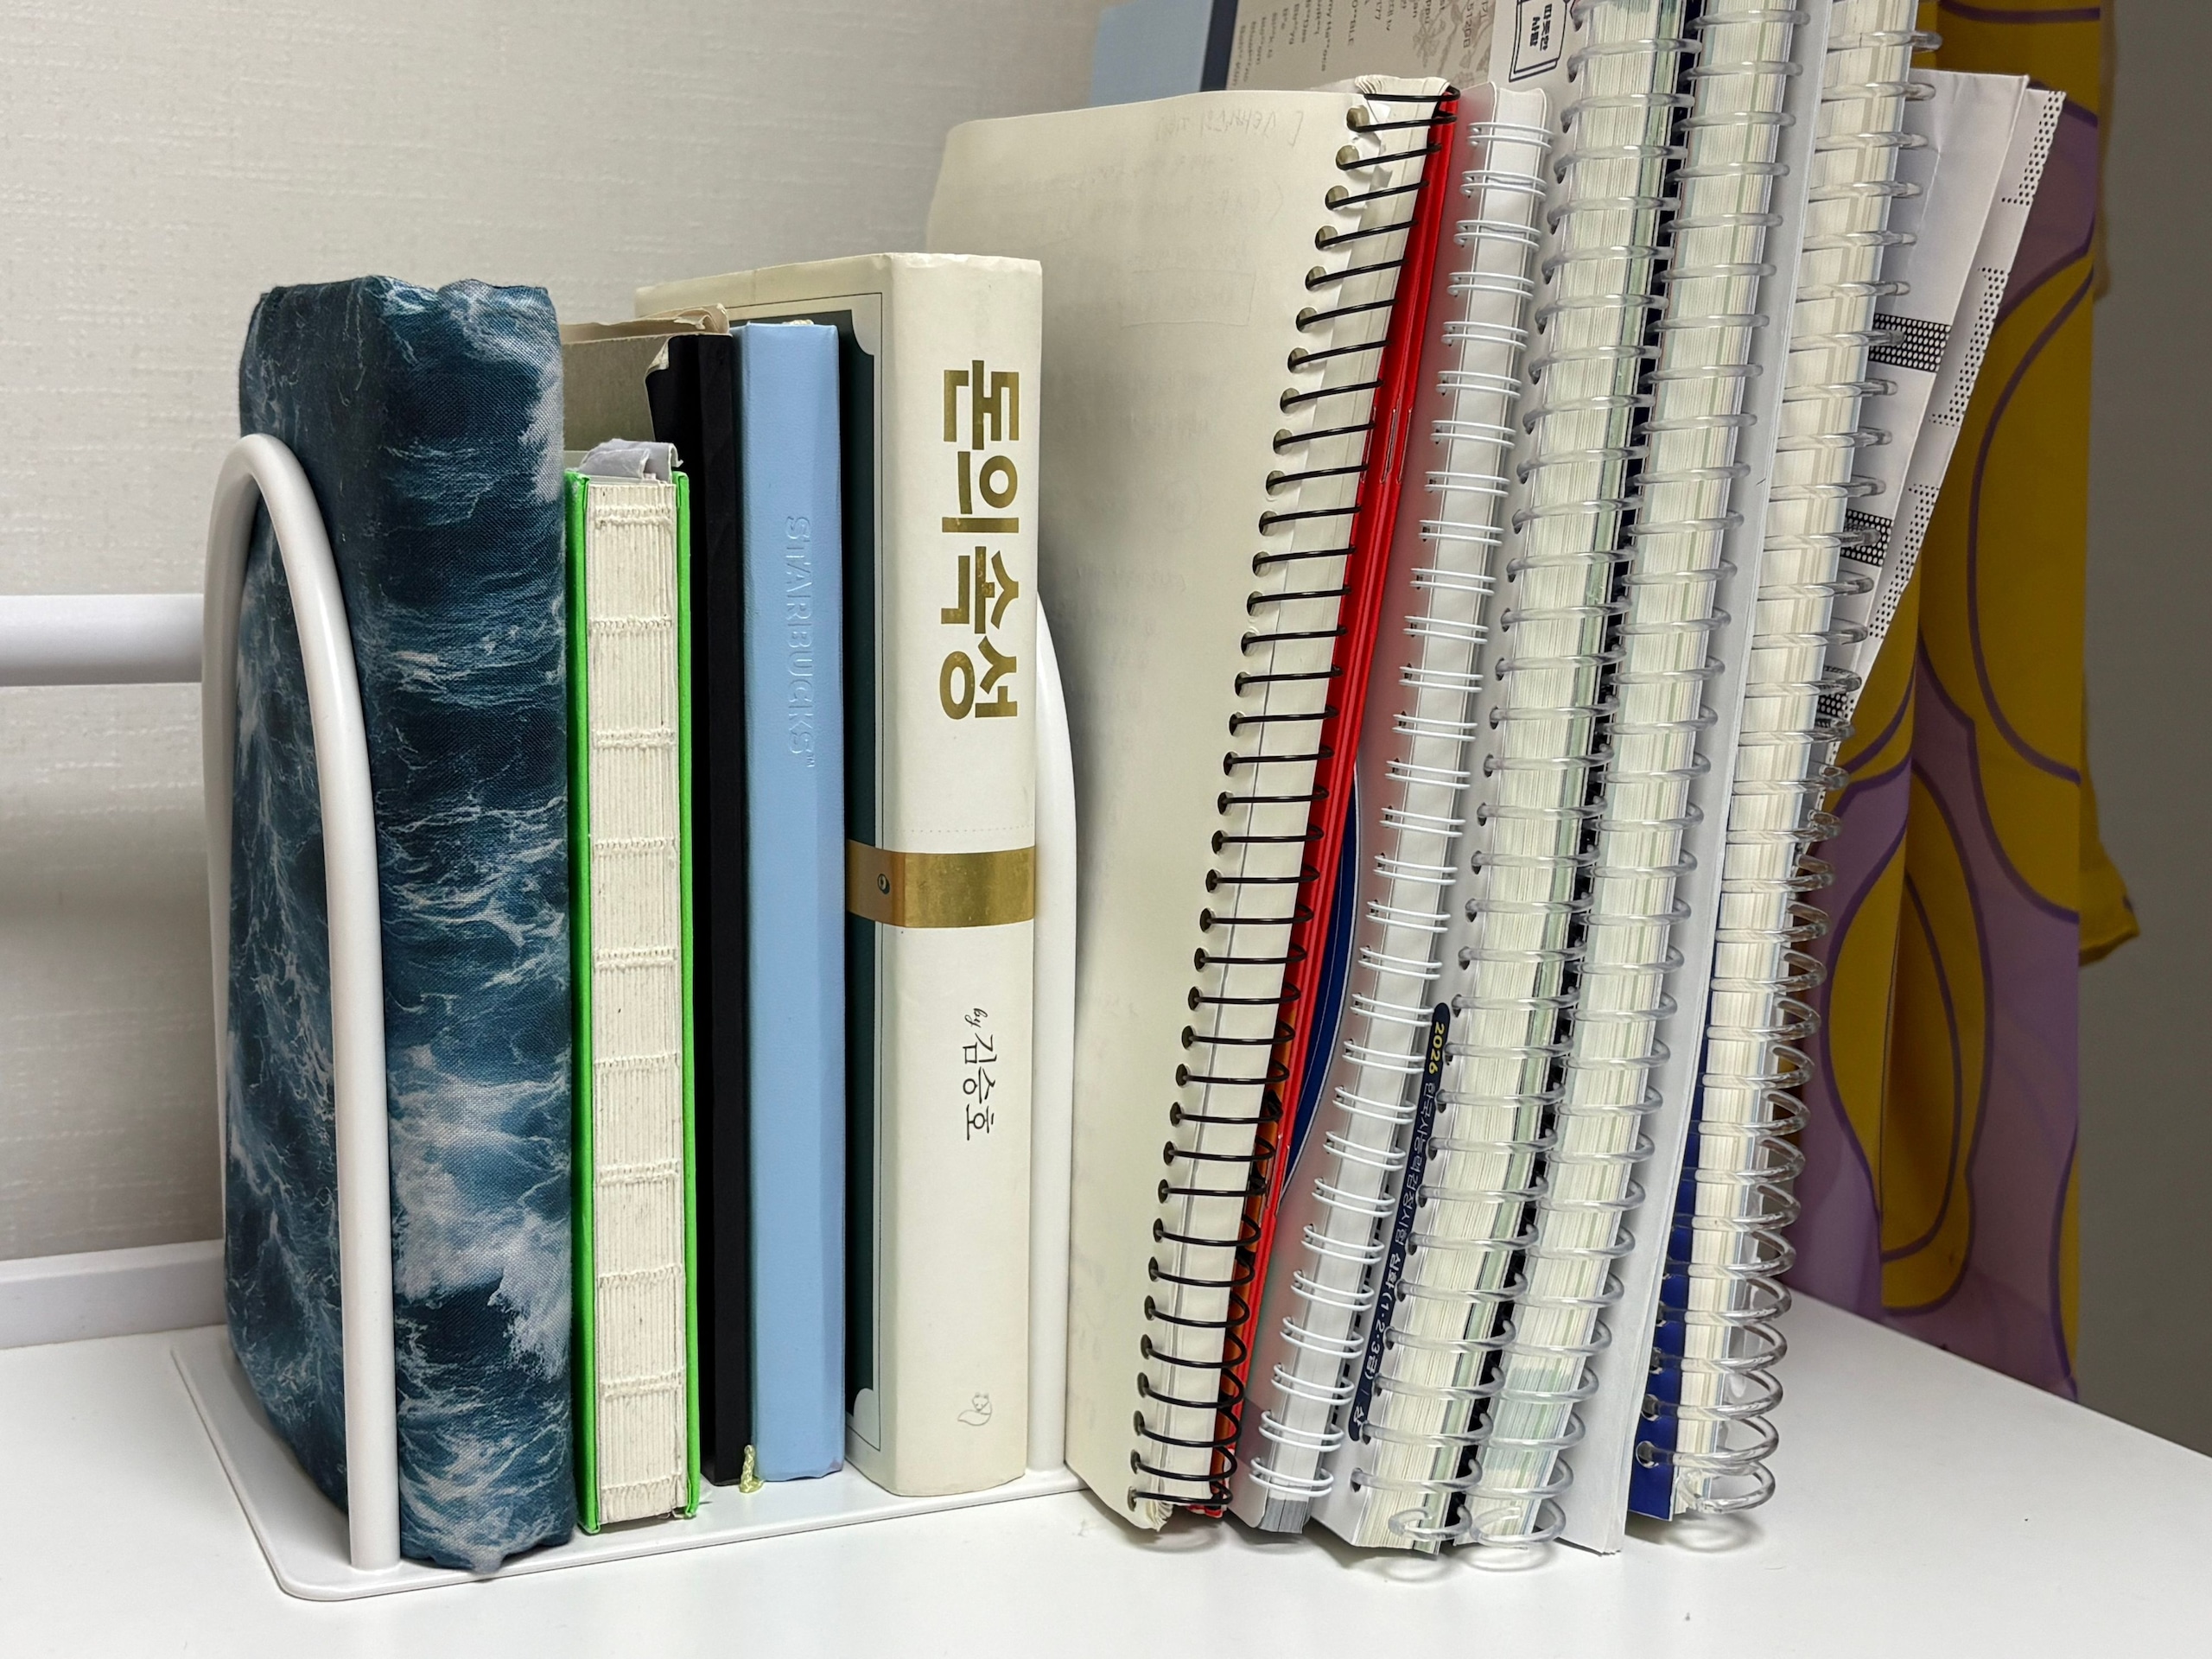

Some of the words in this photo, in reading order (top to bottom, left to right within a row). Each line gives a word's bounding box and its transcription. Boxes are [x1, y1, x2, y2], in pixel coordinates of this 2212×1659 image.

[942, 359, 1019, 533] 돈의
[940, 546, 1019, 720] 속성
[964, 1007, 988, 1028] by
[1428, 1021, 1445, 1074] 2026
[963, 1033, 997, 1141] 김승호
